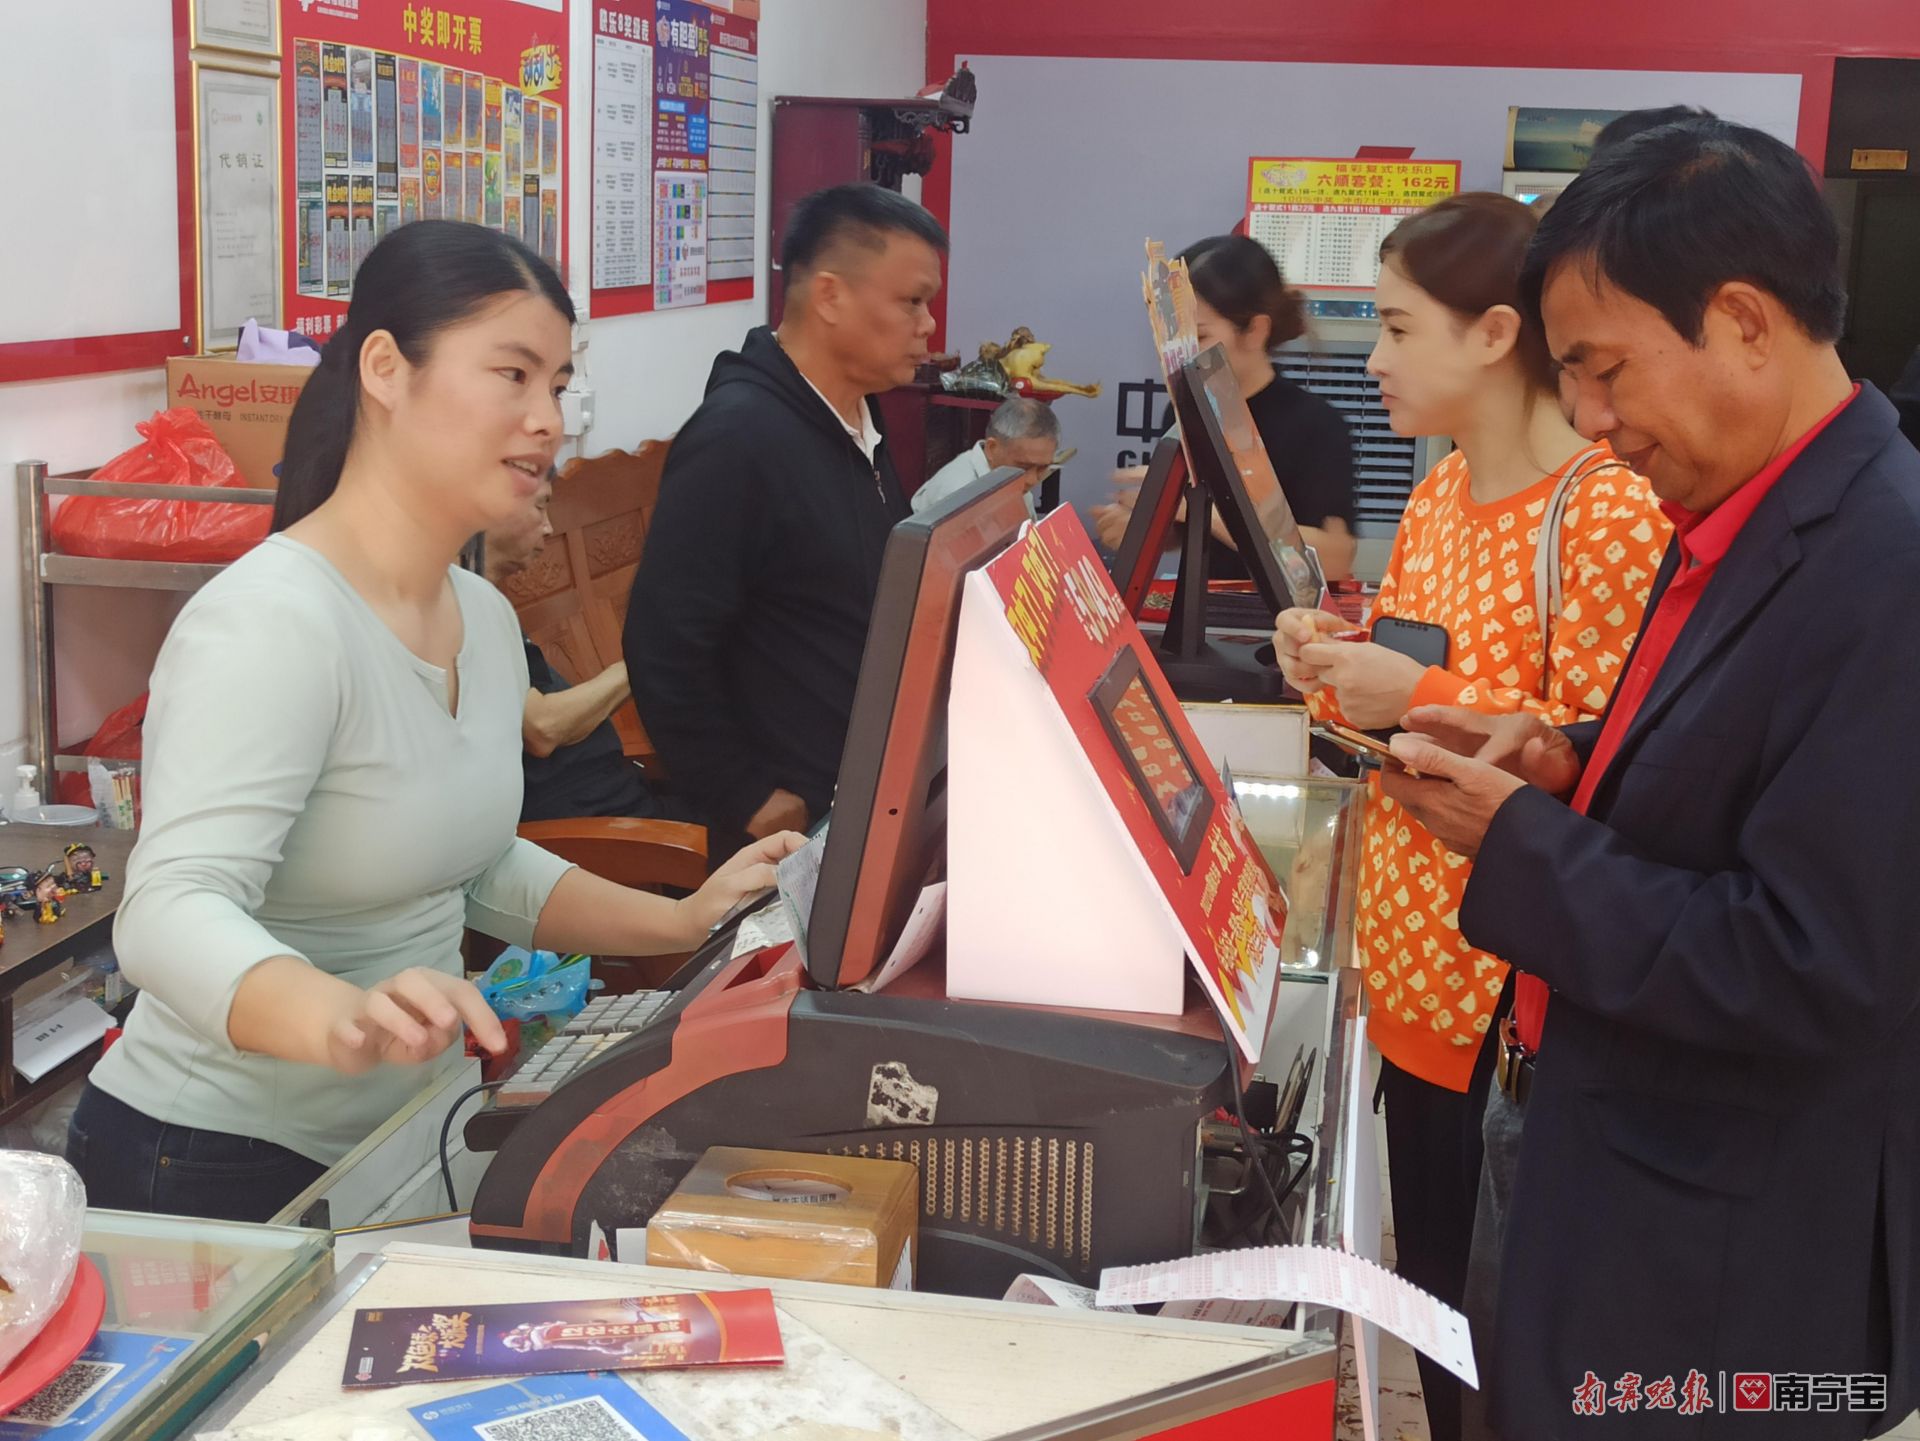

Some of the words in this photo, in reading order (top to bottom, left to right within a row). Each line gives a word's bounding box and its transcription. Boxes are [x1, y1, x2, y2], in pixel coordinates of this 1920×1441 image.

[403, 3, 482, 55] 中奖即开票
[219, 153, 264, 169] 代销证
[177, 373, 257, 407] Angel
